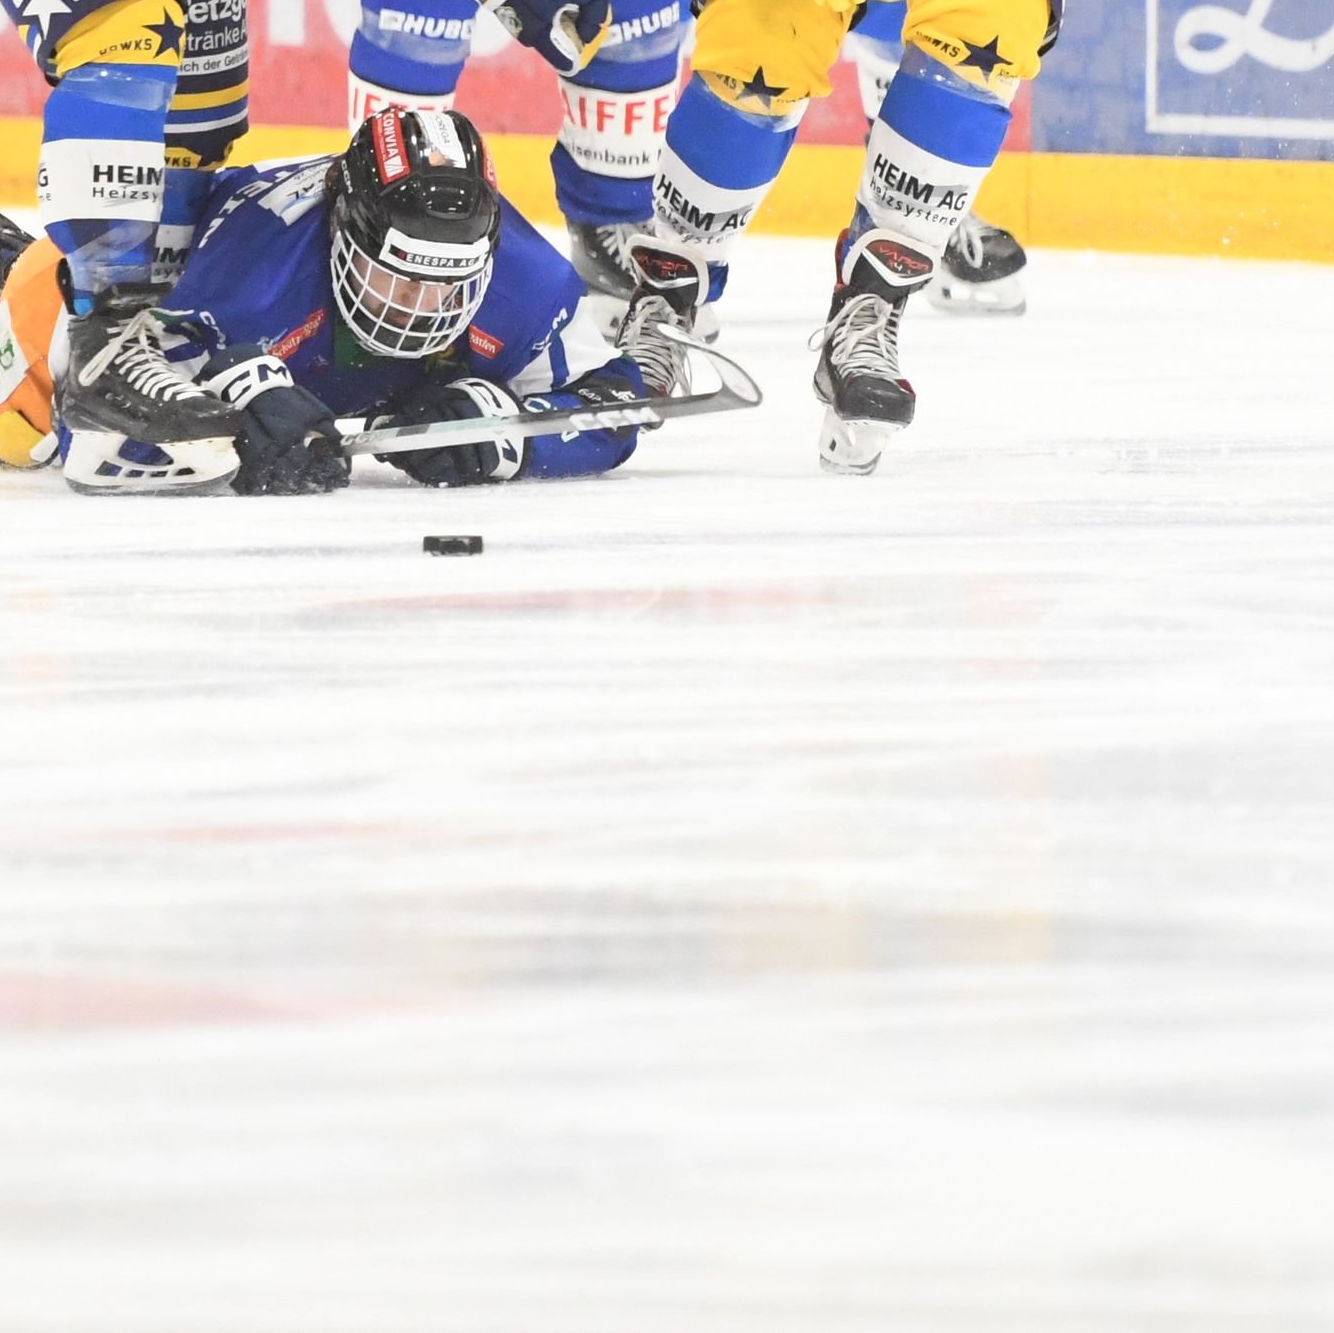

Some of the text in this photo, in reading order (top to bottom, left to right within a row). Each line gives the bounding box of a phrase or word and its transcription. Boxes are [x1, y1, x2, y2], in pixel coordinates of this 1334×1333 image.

[185, 25, 240, 53] tränke
[203, 57, 221, 71] der
[571, 144, 651, 166] isenbank
[91, 185, 161, 203] Heizsy
[872, 153, 969, 212] HEIM AG
[656, 173, 716, 232] HEIM
[569, 407, 661, 432] CCM
